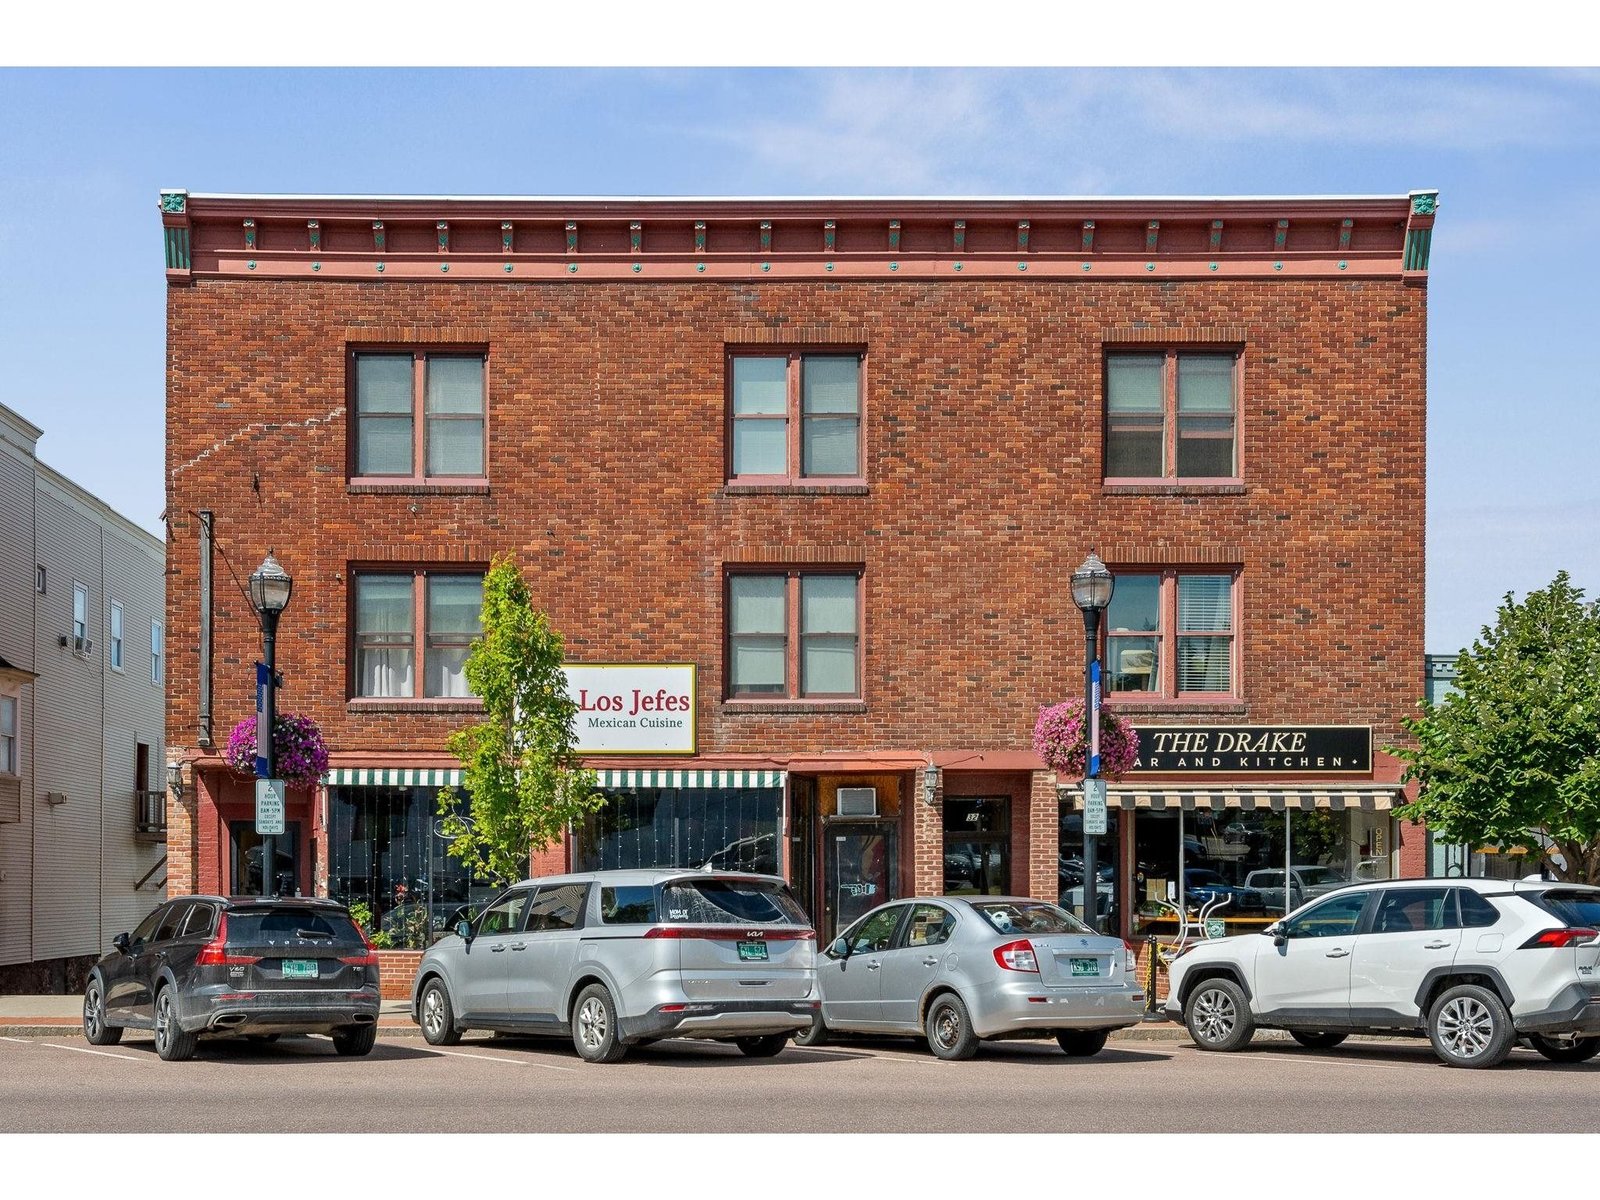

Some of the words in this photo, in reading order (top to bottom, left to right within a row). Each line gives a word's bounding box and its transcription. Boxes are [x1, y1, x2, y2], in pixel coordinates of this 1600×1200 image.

[579, 689, 624, 712] Los
[628, 689, 690, 716] Jefes
[587, 717, 636, 728] Mexican
[639, 717, 683, 728] Cuisine
[1153, 732, 1209, 753] THE
[1214, 732, 1307, 753] DRAKE
[1133, 757, 1159, 767] AR
[1177, 757, 1221, 767] AND
[1240, 757, 1342, 767] KITCHEN
[267, 784, 273, 792] 2
[1093, 784, 1098, 792] 2
